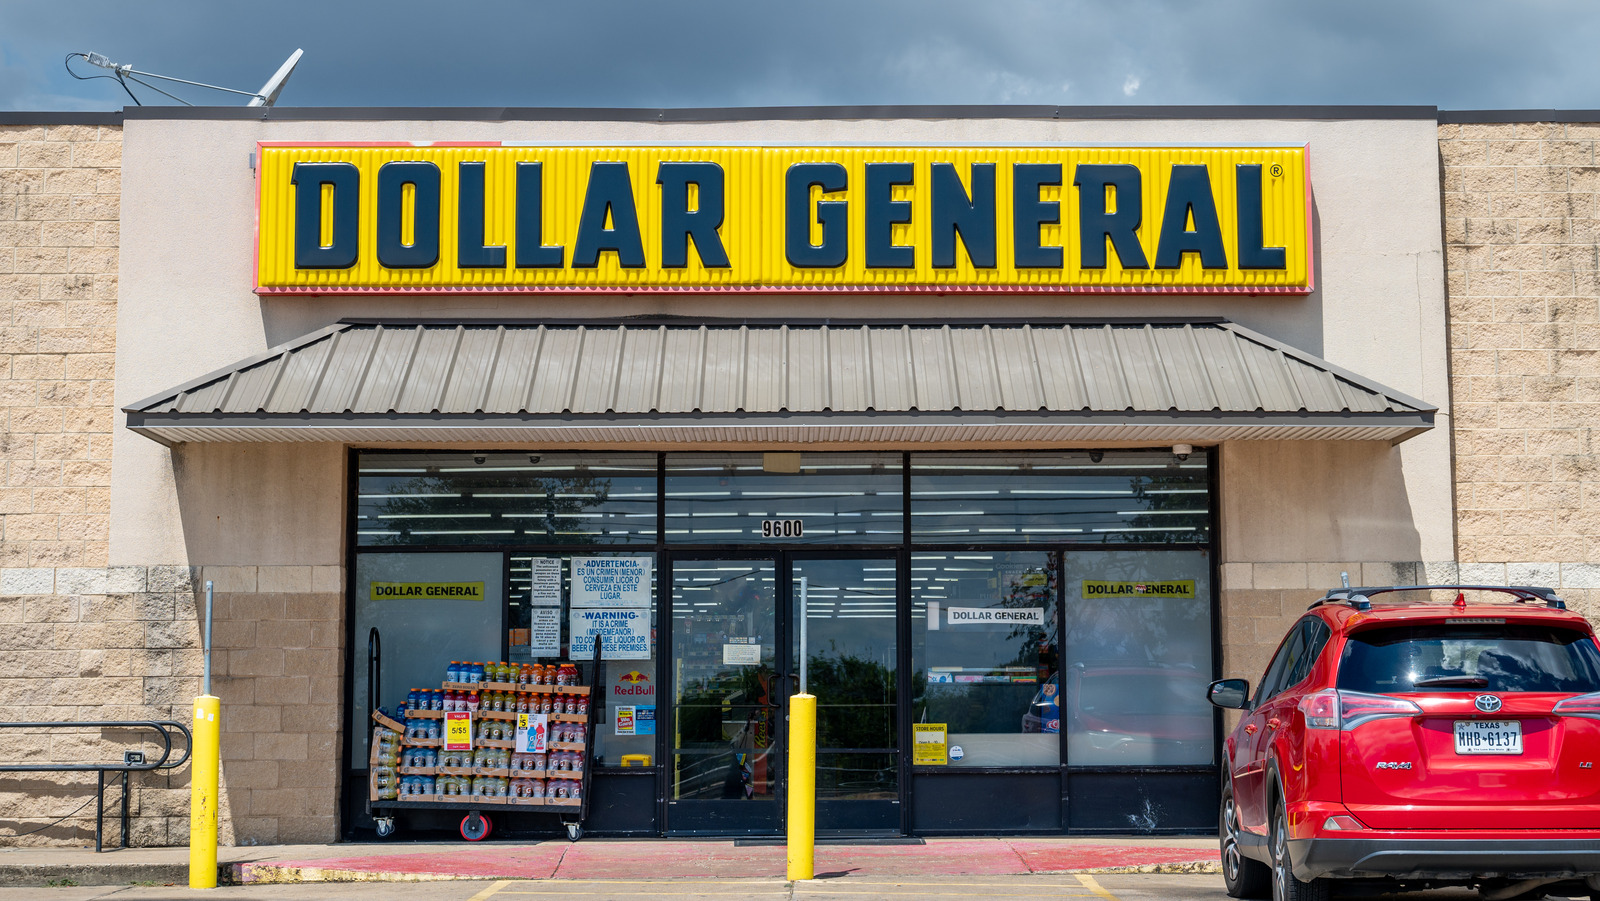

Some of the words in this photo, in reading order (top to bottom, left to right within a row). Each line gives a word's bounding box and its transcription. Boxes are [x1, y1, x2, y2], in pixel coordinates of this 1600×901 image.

[290, 160, 732, 269] DOLLAR
[785, 162, 1286, 270] GENERAL
[763, 520, 802, 536] 9600
[376, 586, 422, 596] DOLLAR
[426, 586, 478, 596] GENERAL
[1087, 584, 1134, 594] DOLLAR
[952, 611, 992, 620] DOLLAR
[994, 612, 1039, 620] GENERAL
[614, 685, 634, 695] Red
[636, 685, 654, 695] Bull
[1376, 762, 1412, 770] RAV4
